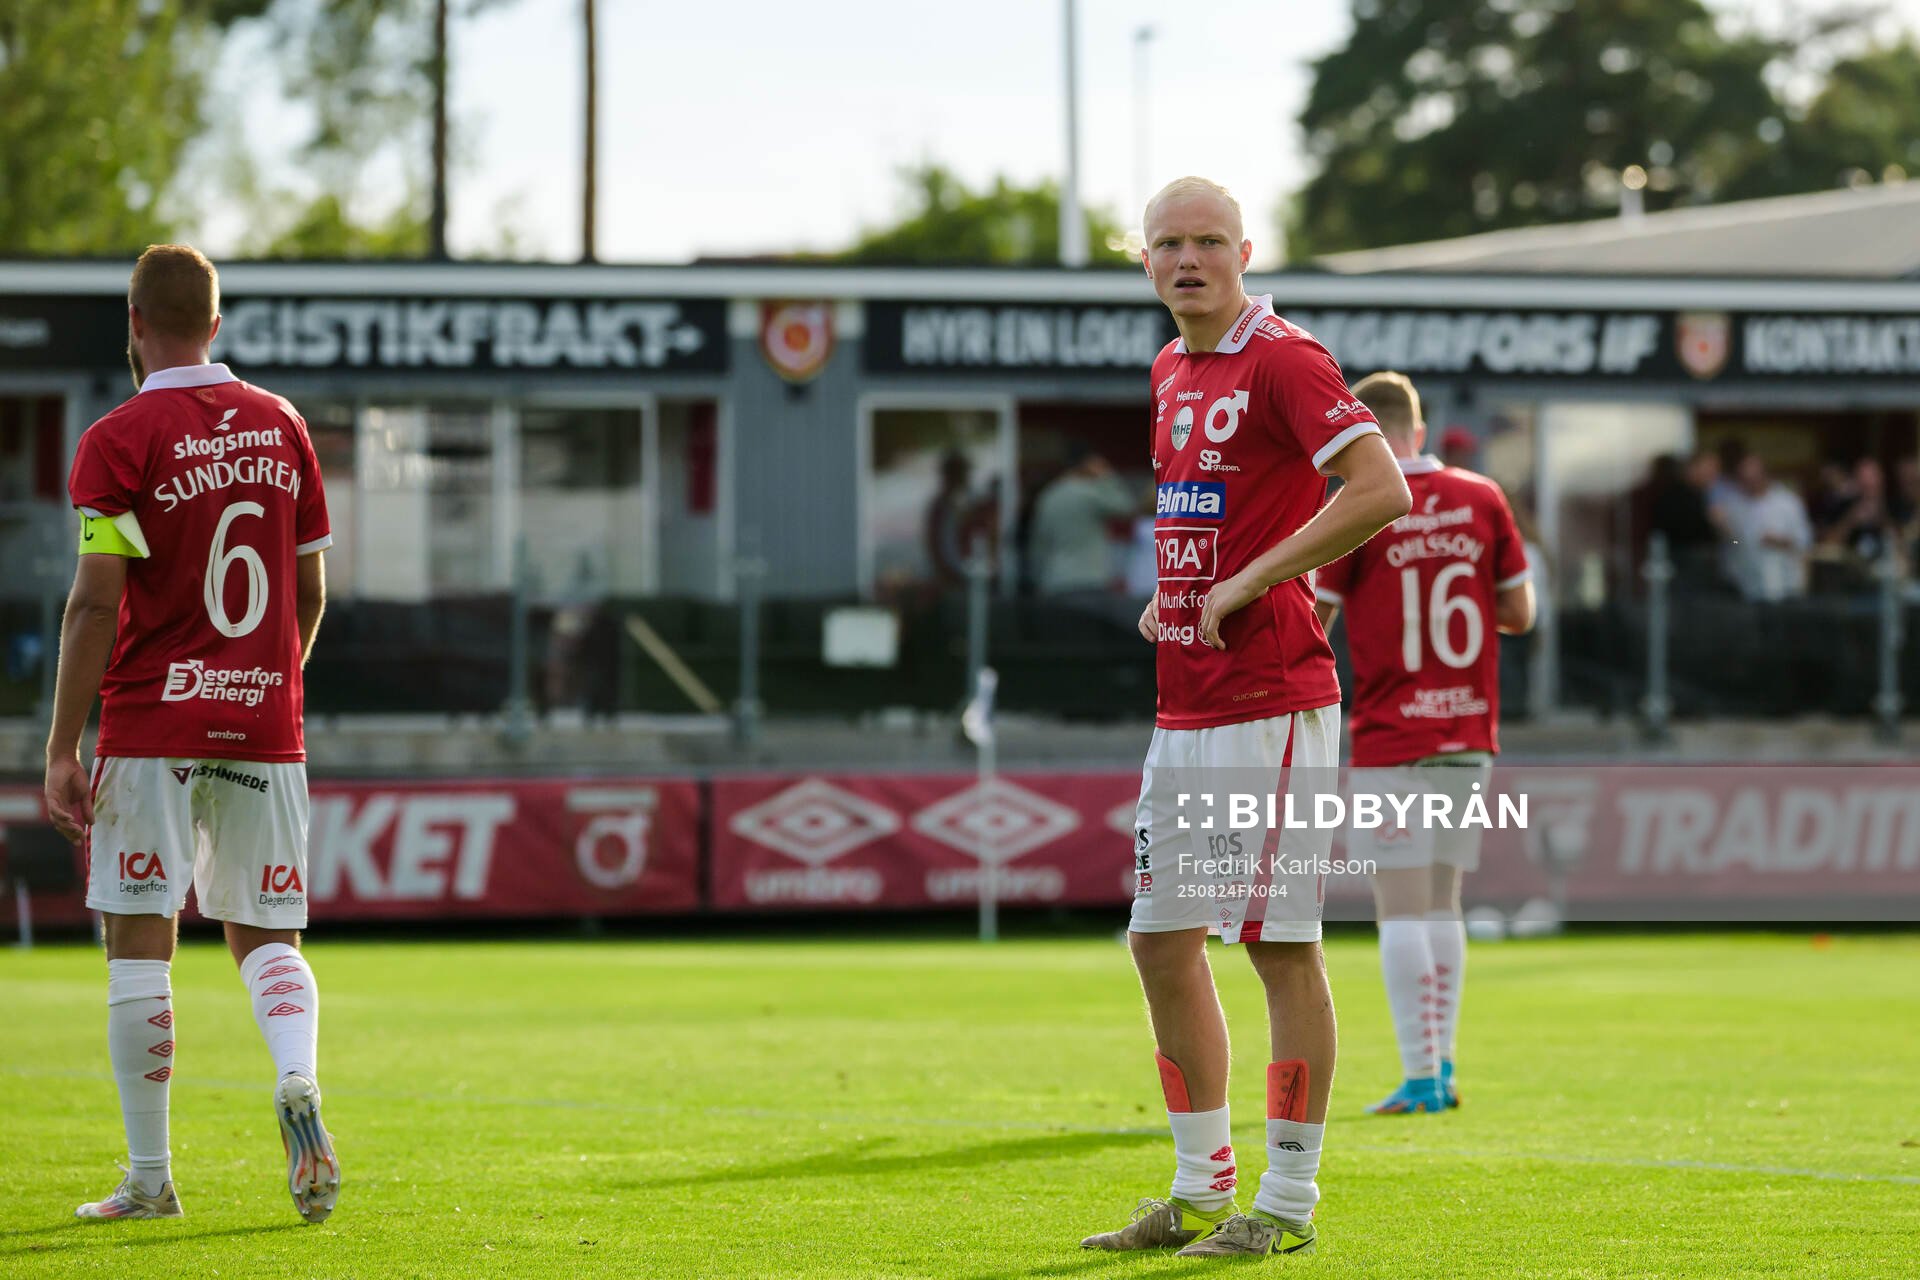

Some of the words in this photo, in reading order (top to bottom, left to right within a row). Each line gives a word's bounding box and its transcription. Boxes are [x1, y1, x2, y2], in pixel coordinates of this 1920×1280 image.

[1283, 312, 1597, 374] EGERFORS
[1601, 312, 1661, 374] IF
[1176, 390, 1204, 402] Helmia
[174, 426, 283, 460] skogsmat
[154, 456, 302, 513] SUNDGREN
[1157, 485, 1221, 514] elmia
[204, 501, 269, 638] 6
[1400, 562, 1485, 673] 16
[200, 682, 265, 706] Energi
[1232, 689, 1269, 702] QUICKDRY
[207, 730, 246, 741] umbro
[308, 793, 515, 900] KET
[119, 852, 167, 880] ICA
[261, 864, 303, 893] ICA
[120, 881, 168, 895] Degerfors
[259, 894, 303, 908] Degerfors
